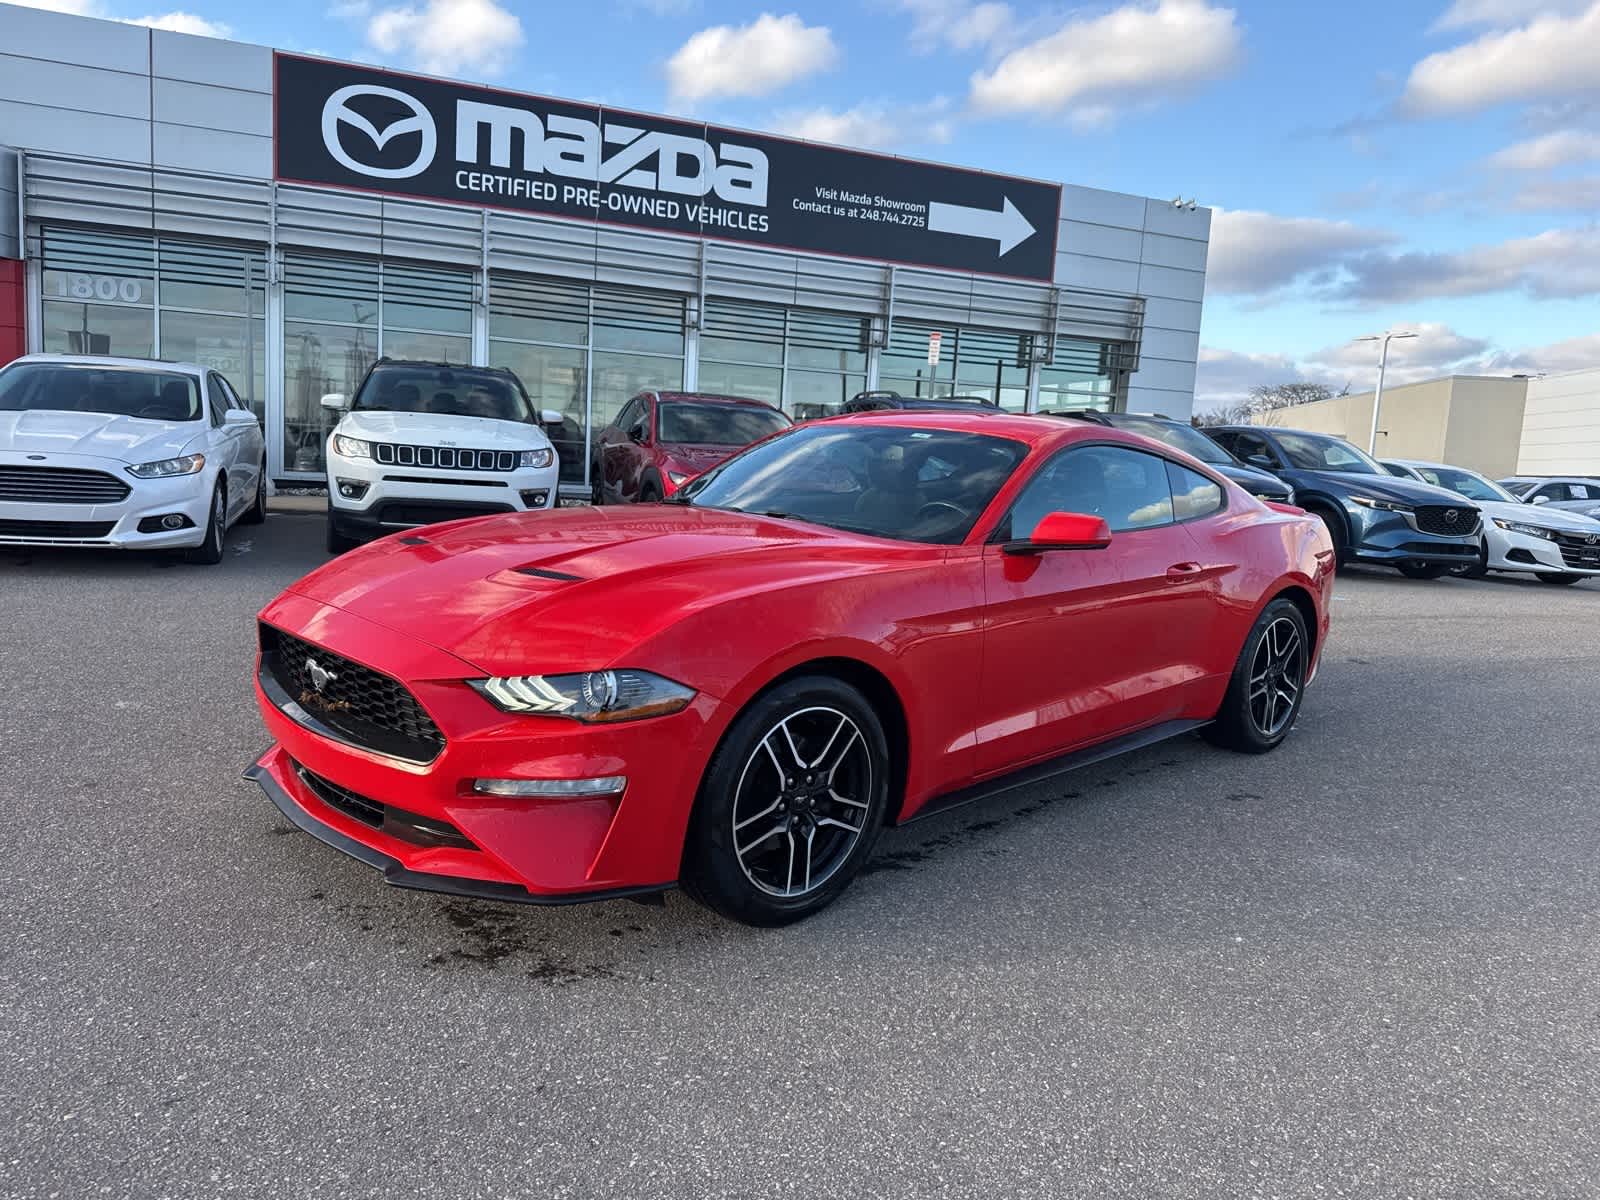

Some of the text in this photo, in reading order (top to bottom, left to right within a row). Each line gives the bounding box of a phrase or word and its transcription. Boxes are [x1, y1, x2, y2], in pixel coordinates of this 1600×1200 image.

[455, 170, 769, 232] CERTIFIED PRE-OWNED VEHICLES
[792, 198, 925, 227] Contact us at 248.744.2725
[815, 186, 926, 213] Visit Mazda Showroom
[56, 273, 142, 302] 1800
